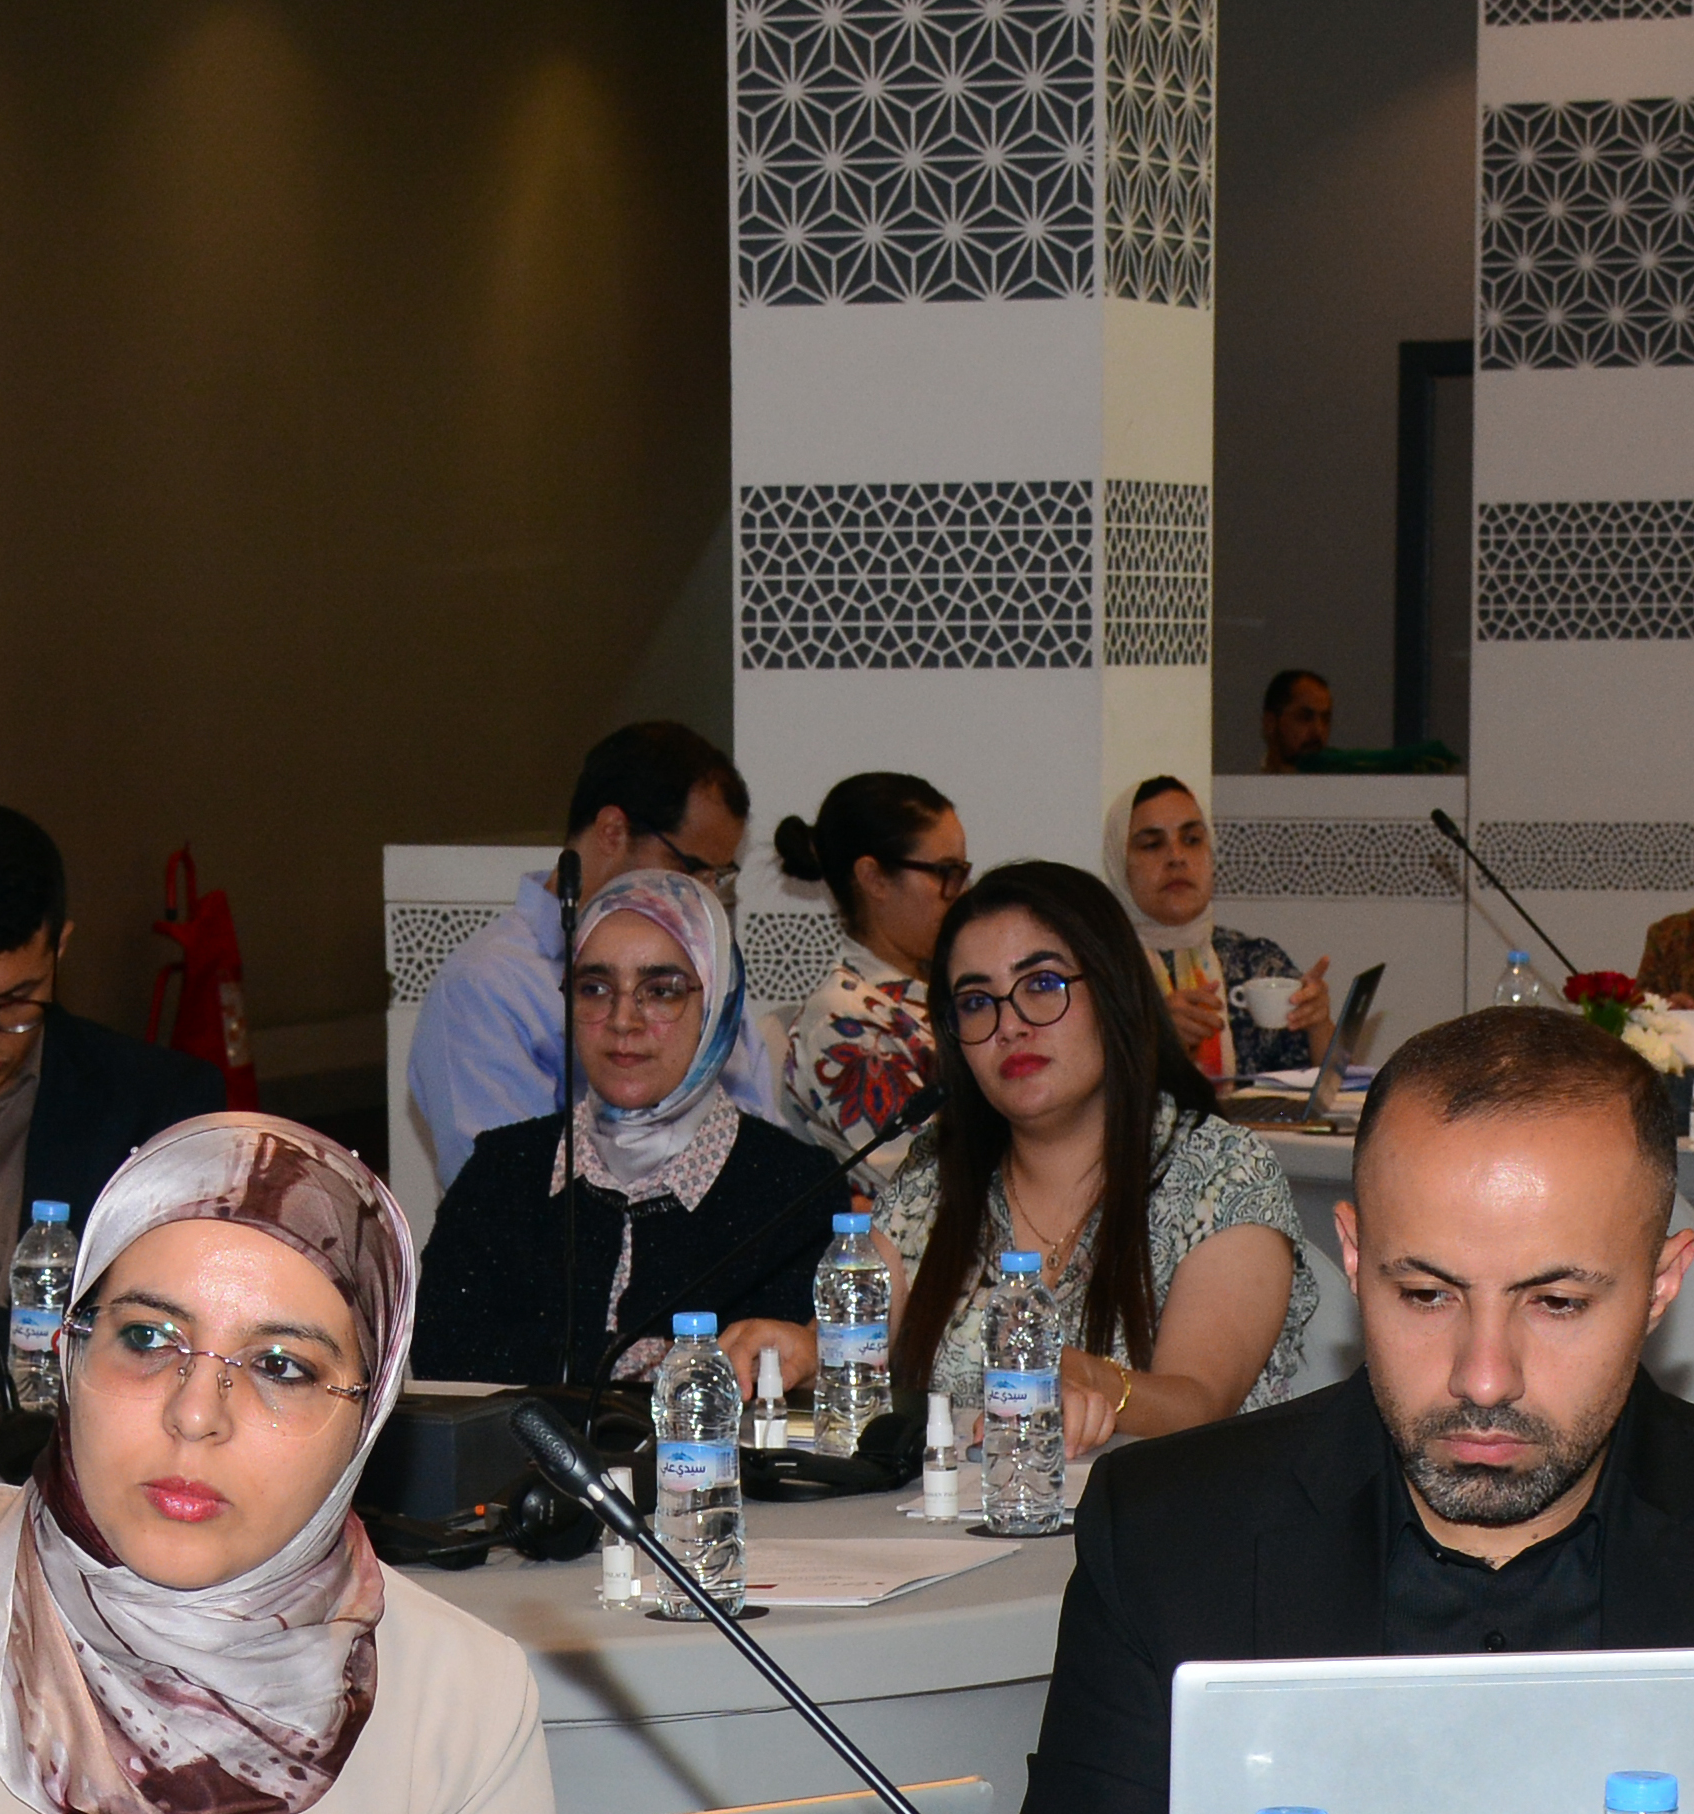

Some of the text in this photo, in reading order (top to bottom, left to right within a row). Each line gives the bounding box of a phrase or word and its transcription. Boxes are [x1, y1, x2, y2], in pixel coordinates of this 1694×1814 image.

[1001, 1393, 1028, 1403] سيدي
[660, 1462, 706, 1477] سيدي علي
